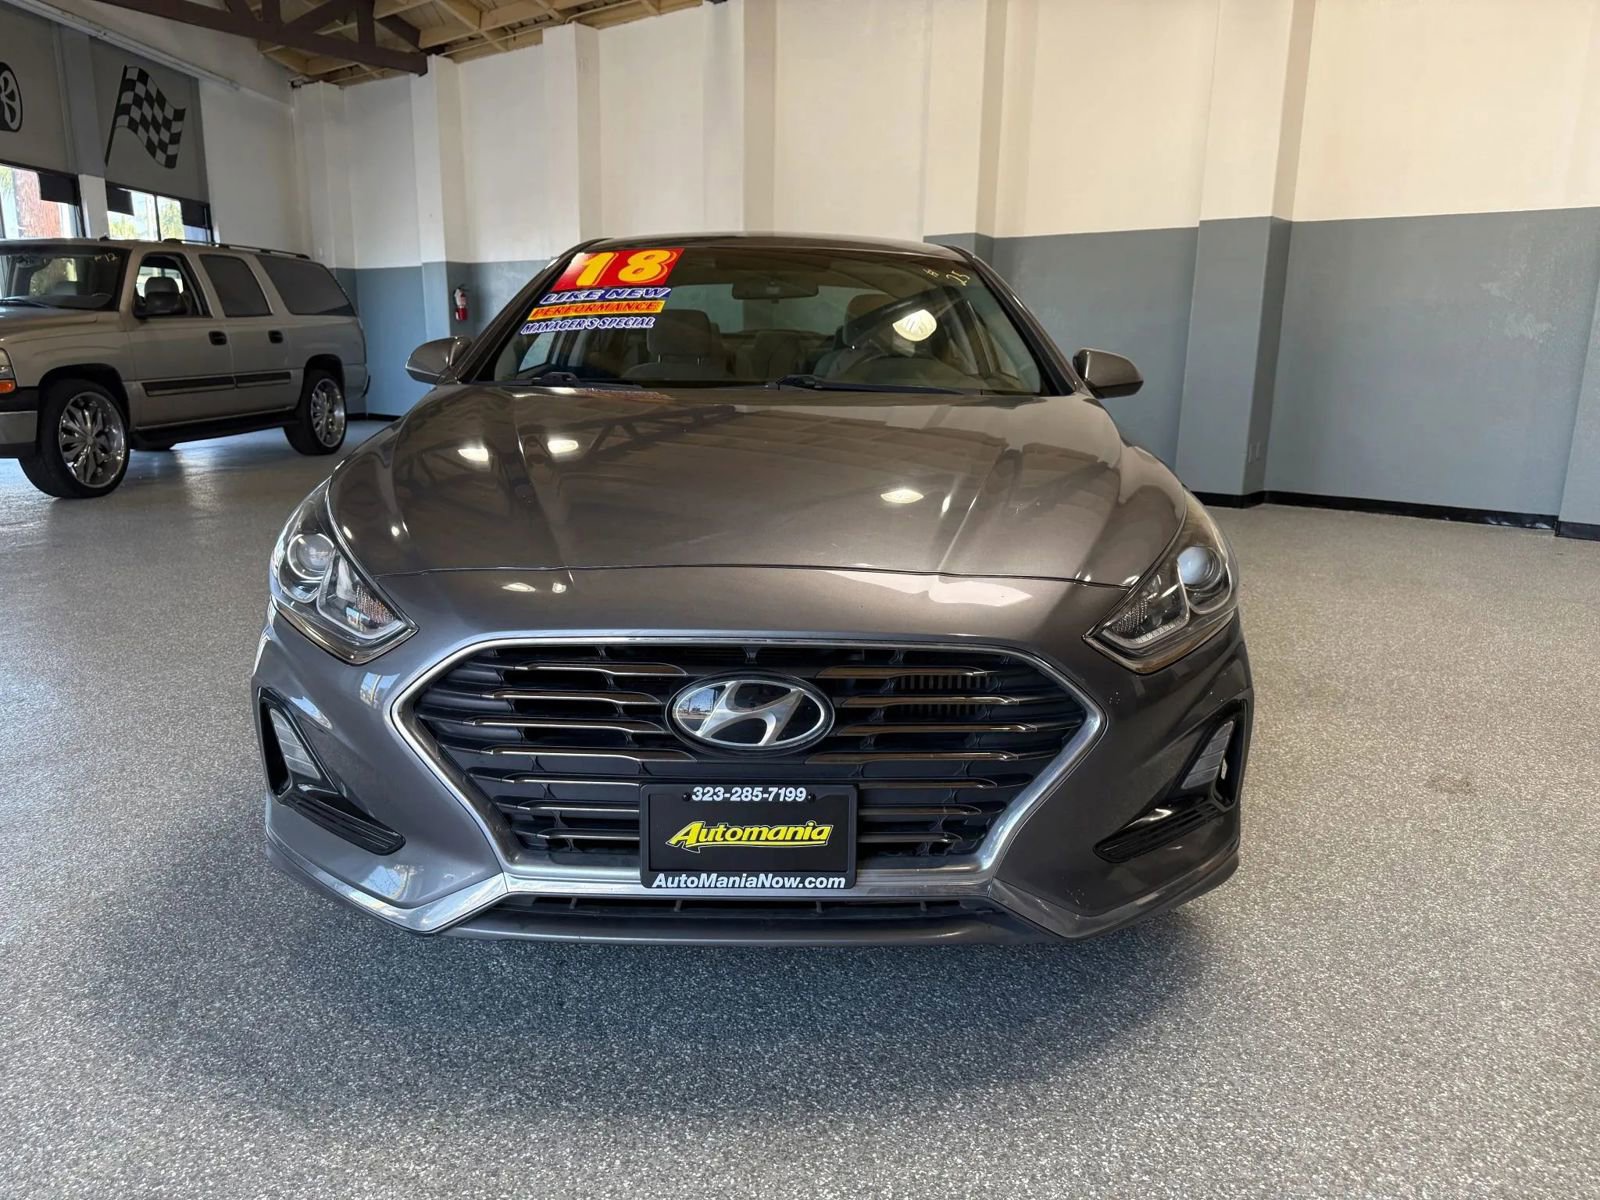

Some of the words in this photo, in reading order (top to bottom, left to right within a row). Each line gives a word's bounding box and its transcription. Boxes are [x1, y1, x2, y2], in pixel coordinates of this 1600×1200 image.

[575, 249, 678, 287] 18
[540, 289, 605, 304] LIKE
[605, 287, 672, 299] NEW
[531, 302, 660, 318] PERFORMANCE
[598, 316, 656, 329] SPECIAL
[692, 786, 807, 802] 323-285-7199
[665, 820, 834, 853] Automania
[652, 873, 846, 889] AutoManiaNow.com
